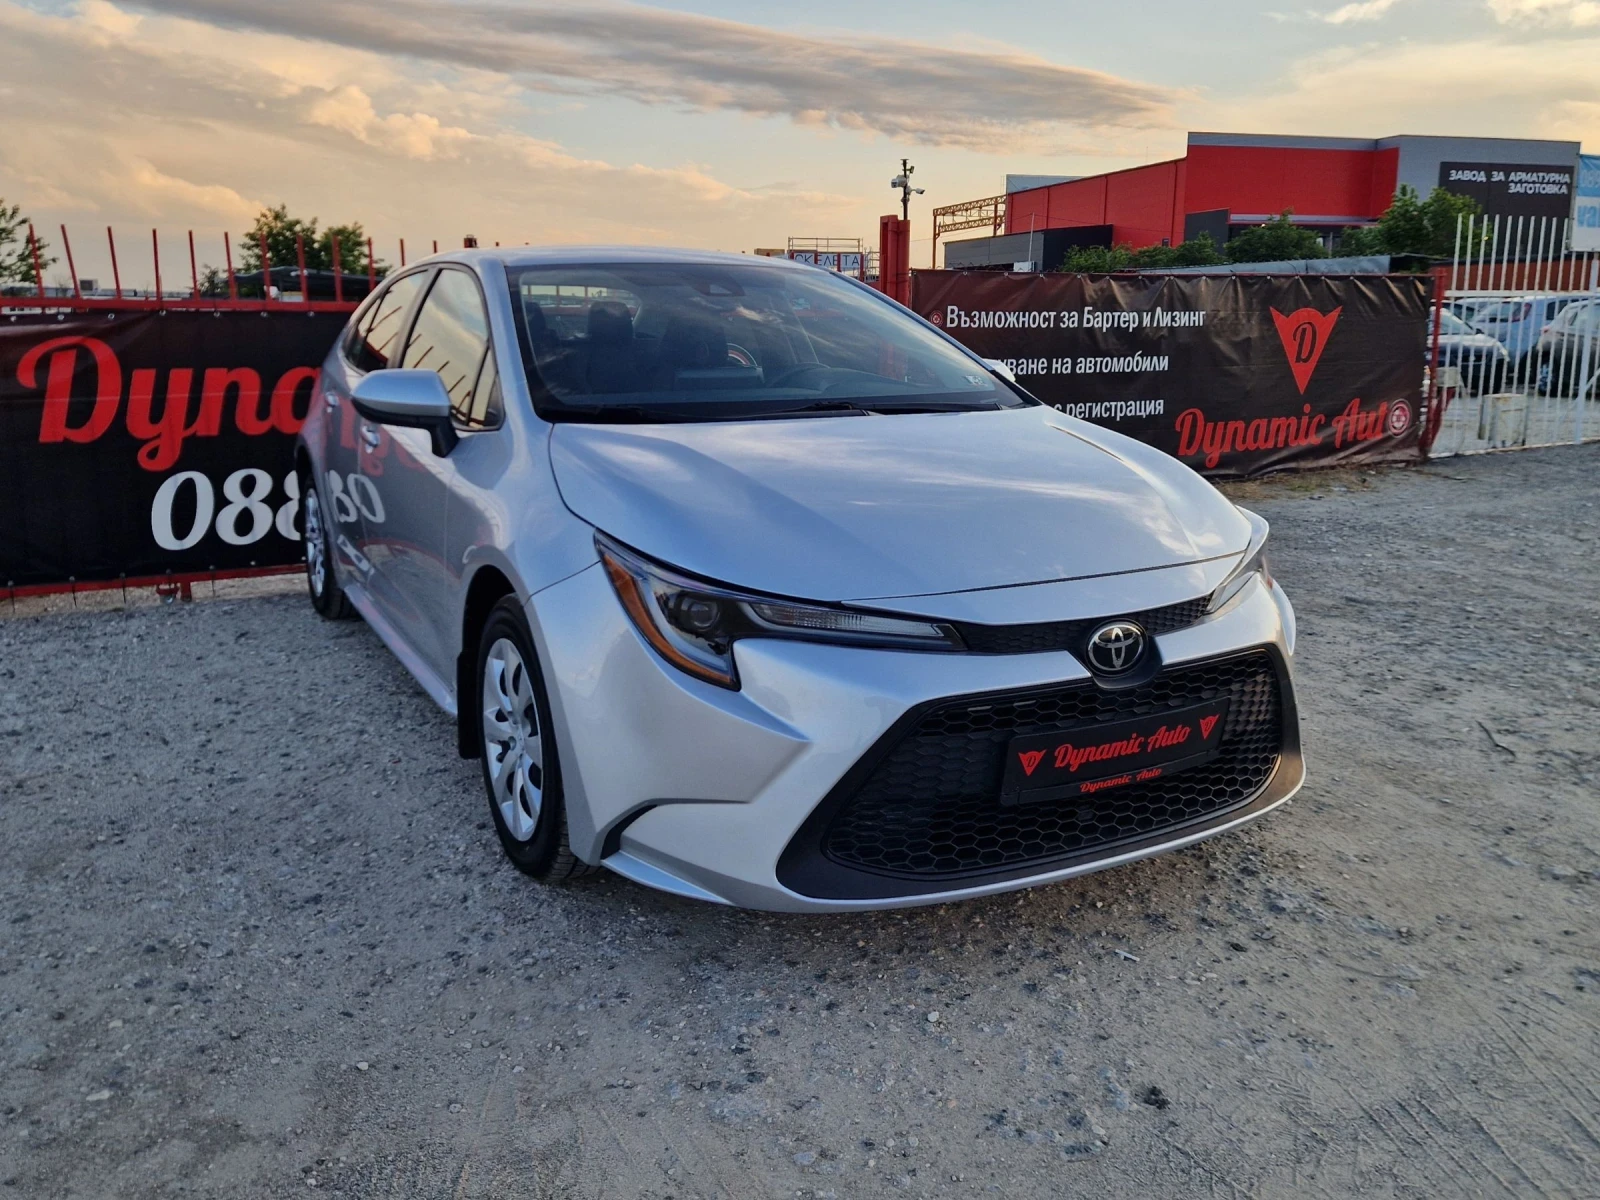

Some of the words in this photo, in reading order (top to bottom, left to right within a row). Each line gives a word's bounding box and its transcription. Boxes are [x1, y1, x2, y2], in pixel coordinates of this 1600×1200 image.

[1449, 169, 1487, 183] ЗАВОД
[1491, 170, 1505, 182] ЗА
[1508, 171, 1571, 183] АРМАТУРНА
[1508, 182, 1568, 195] ЗАГОТОВКА
[946, 305, 1057, 328] Възможност
[1059, 311, 1079, 328] за
[1082, 306, 1139, 333] Бартер
[1142, 311, 1152, 328] и
[1153, 306, 1206, 328] Лизинг
[1292, 321, 1317, 364] D
[1051, 358, 1072, 375] на
[1075, 350, 1169, 374] автомобили
[1066, 399, 1165, 421] регистрация
[1175, 403, 1325, 468] Dynamic
[1054, 733, 1145, 772] Dynamic
[1147, 725, 1191, 752] Auto
[1080, 774, 1132, 793] Dynamic
[1136, 767, 1162, 782] Auto
